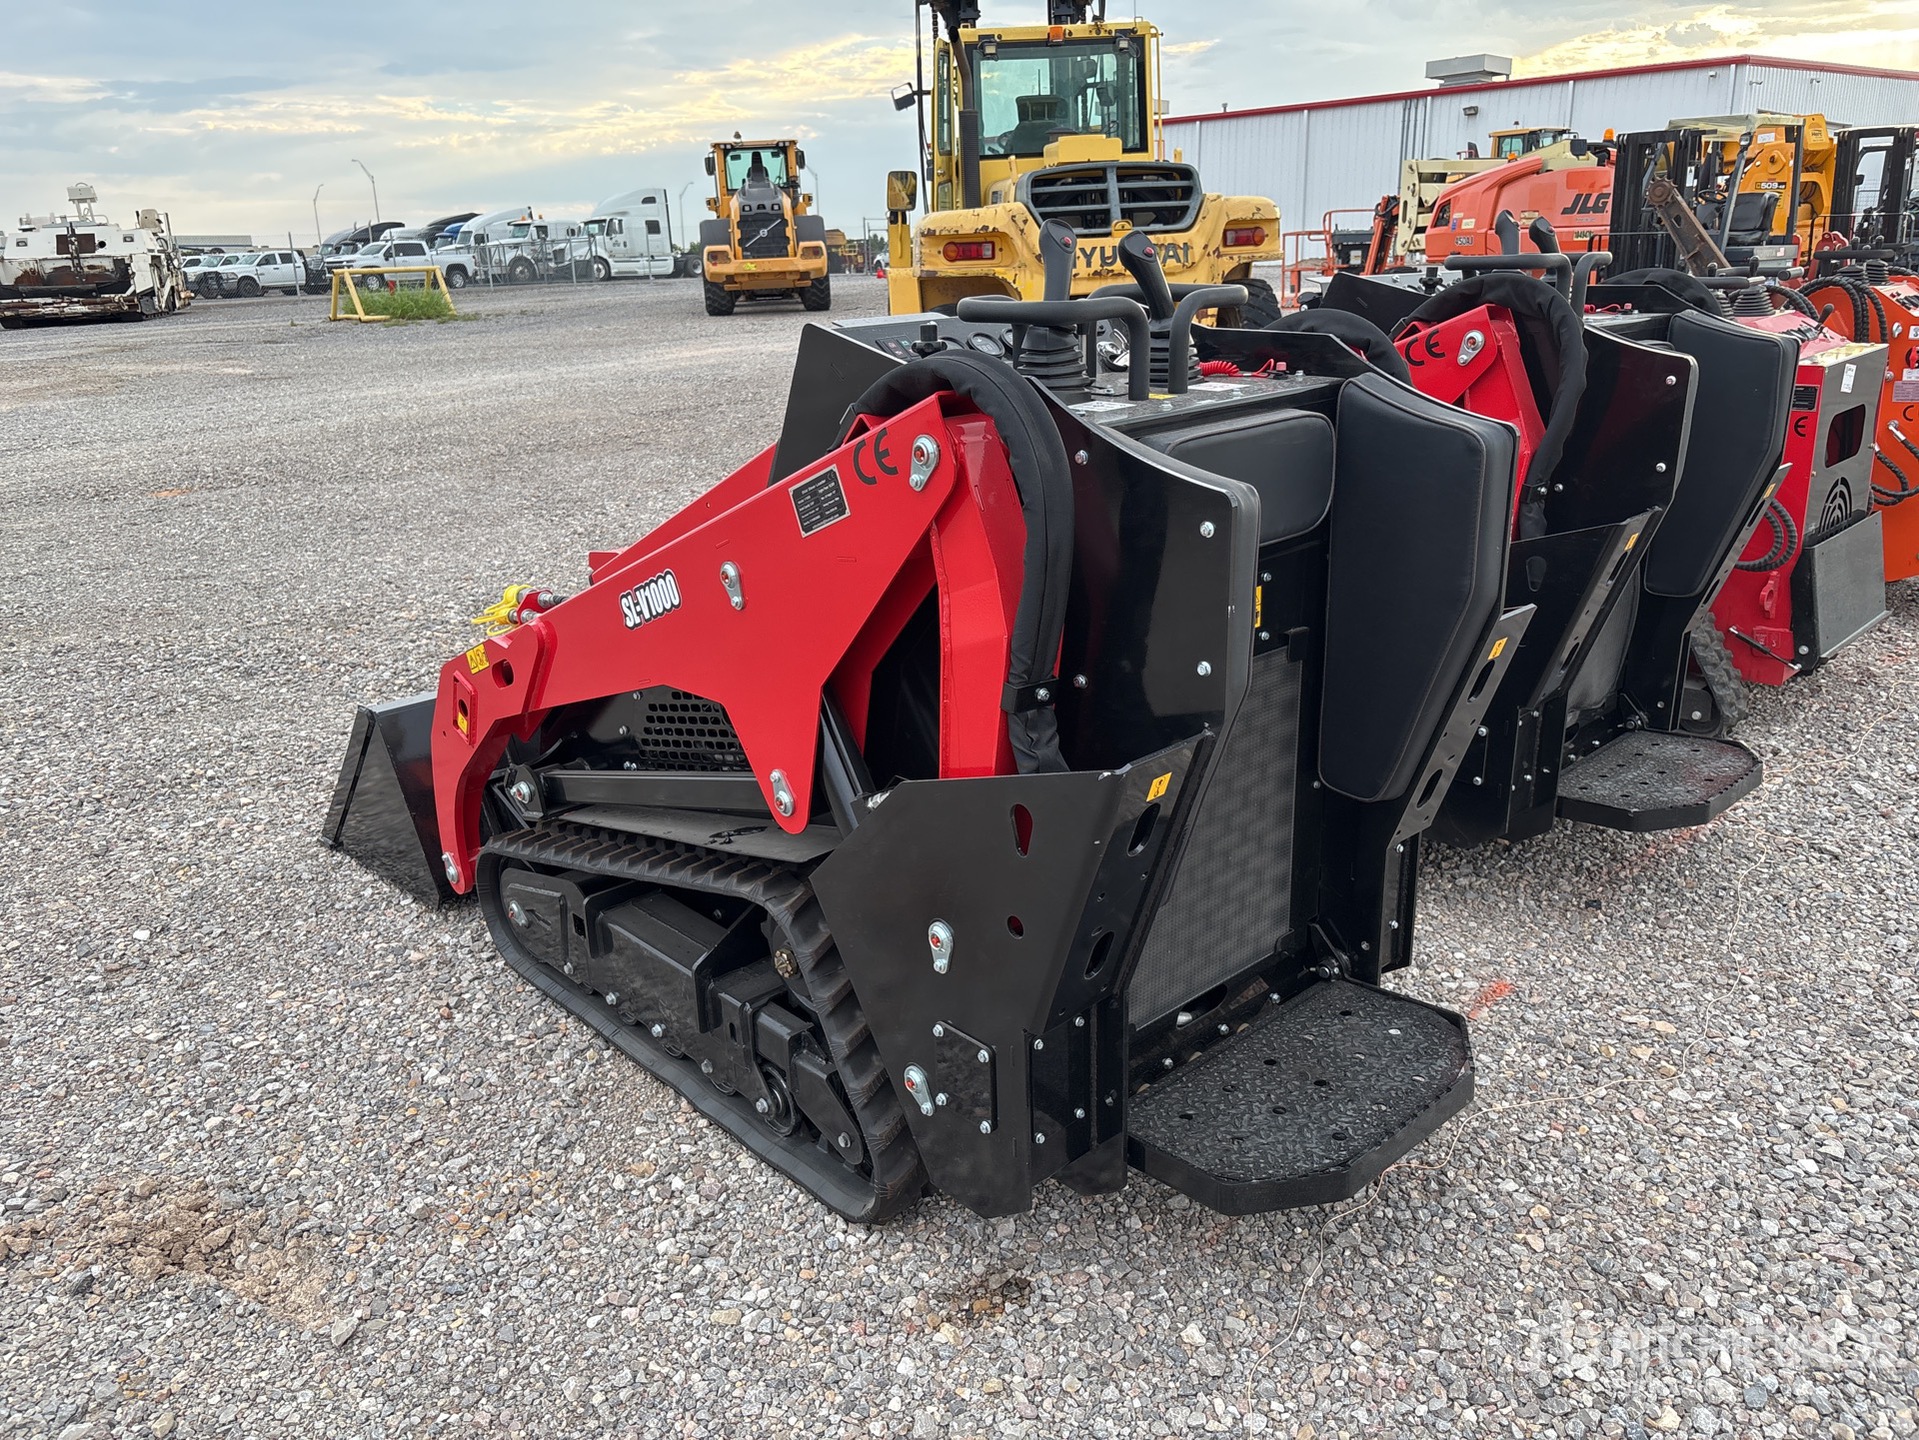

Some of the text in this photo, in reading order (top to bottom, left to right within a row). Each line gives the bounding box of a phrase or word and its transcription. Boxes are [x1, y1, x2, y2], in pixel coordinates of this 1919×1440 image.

[1560, 192, 1611, 215] JLG
[1073, 242, 1190, 269] YUAI
[1404, 328, 1446, 366] CE
[1902, 404, 1919, 422] C
[853, 427, 899, 485] CE
[620, 572, 681, 629] SL-V1000
